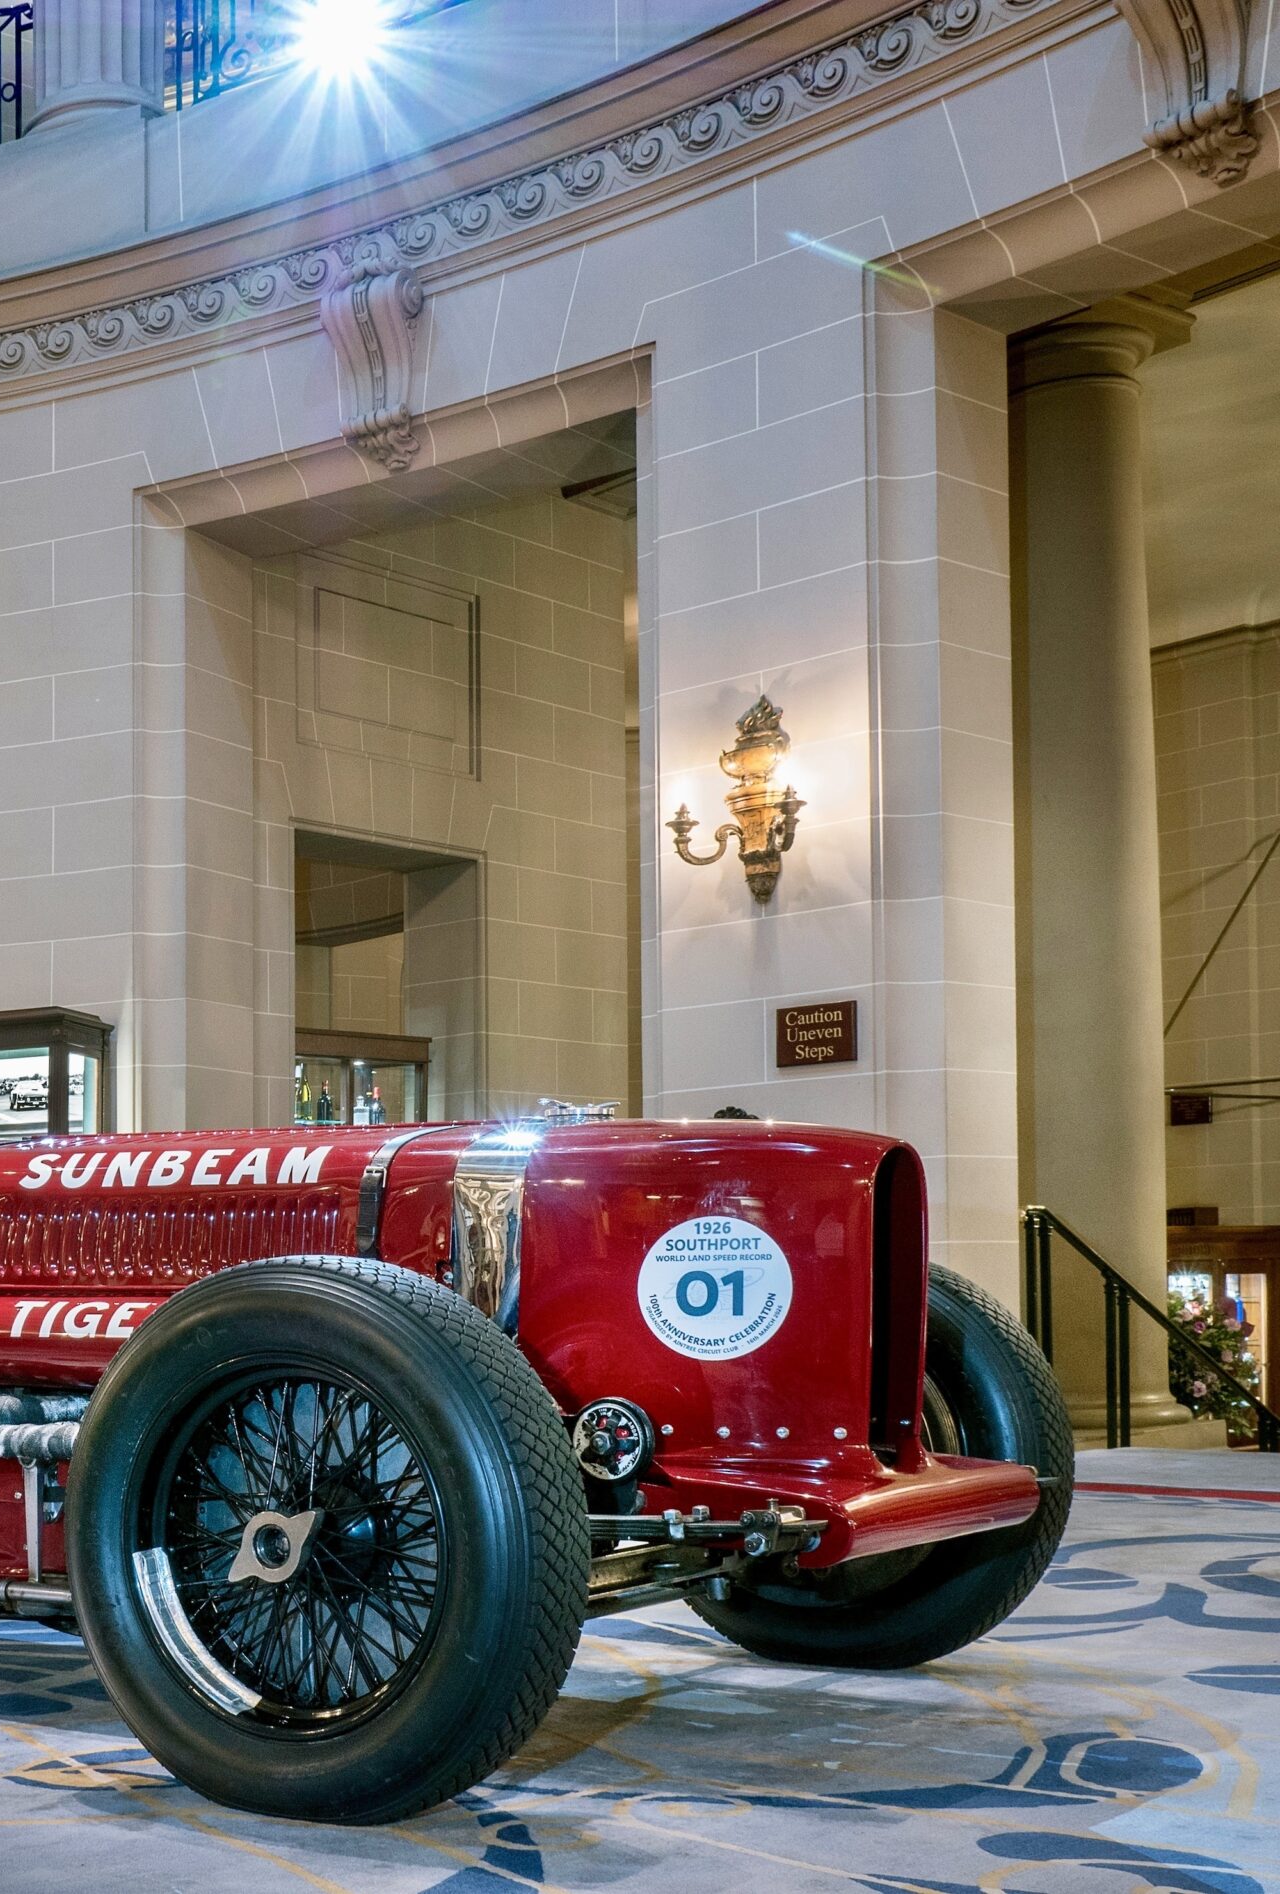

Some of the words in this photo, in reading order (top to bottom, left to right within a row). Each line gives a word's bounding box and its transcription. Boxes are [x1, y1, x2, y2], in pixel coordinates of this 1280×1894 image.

[785, 1008, 843, 1026] Caution
[786, 1027, 842, 1042] Uneven
[795, 1044, 834, 1061] Steps
[19, 1146, 333, 1189] SUNBEAM
[694, 1222, 731, 1234] 1926
[665, 1238, 761, 1251] SOUTHPORT
[687, 1254, 711, 1262] LAND
[739, 1253, 773, 1261] RECORD
[676, 1271, 743, 1316] 01
[10, 1302, 151, 1338] TIGE
[649, 1294, 662, 1318] 100th
[660, 1318, 726, 1347] ANNIVERSARY
[728, 1292, 777, 1343] CELEBRATION
[665, 1333, 674, 1341] BY
[723, 1345, 739, 1354] CLUB
[758, 1318, 776, 1337] MARCH
